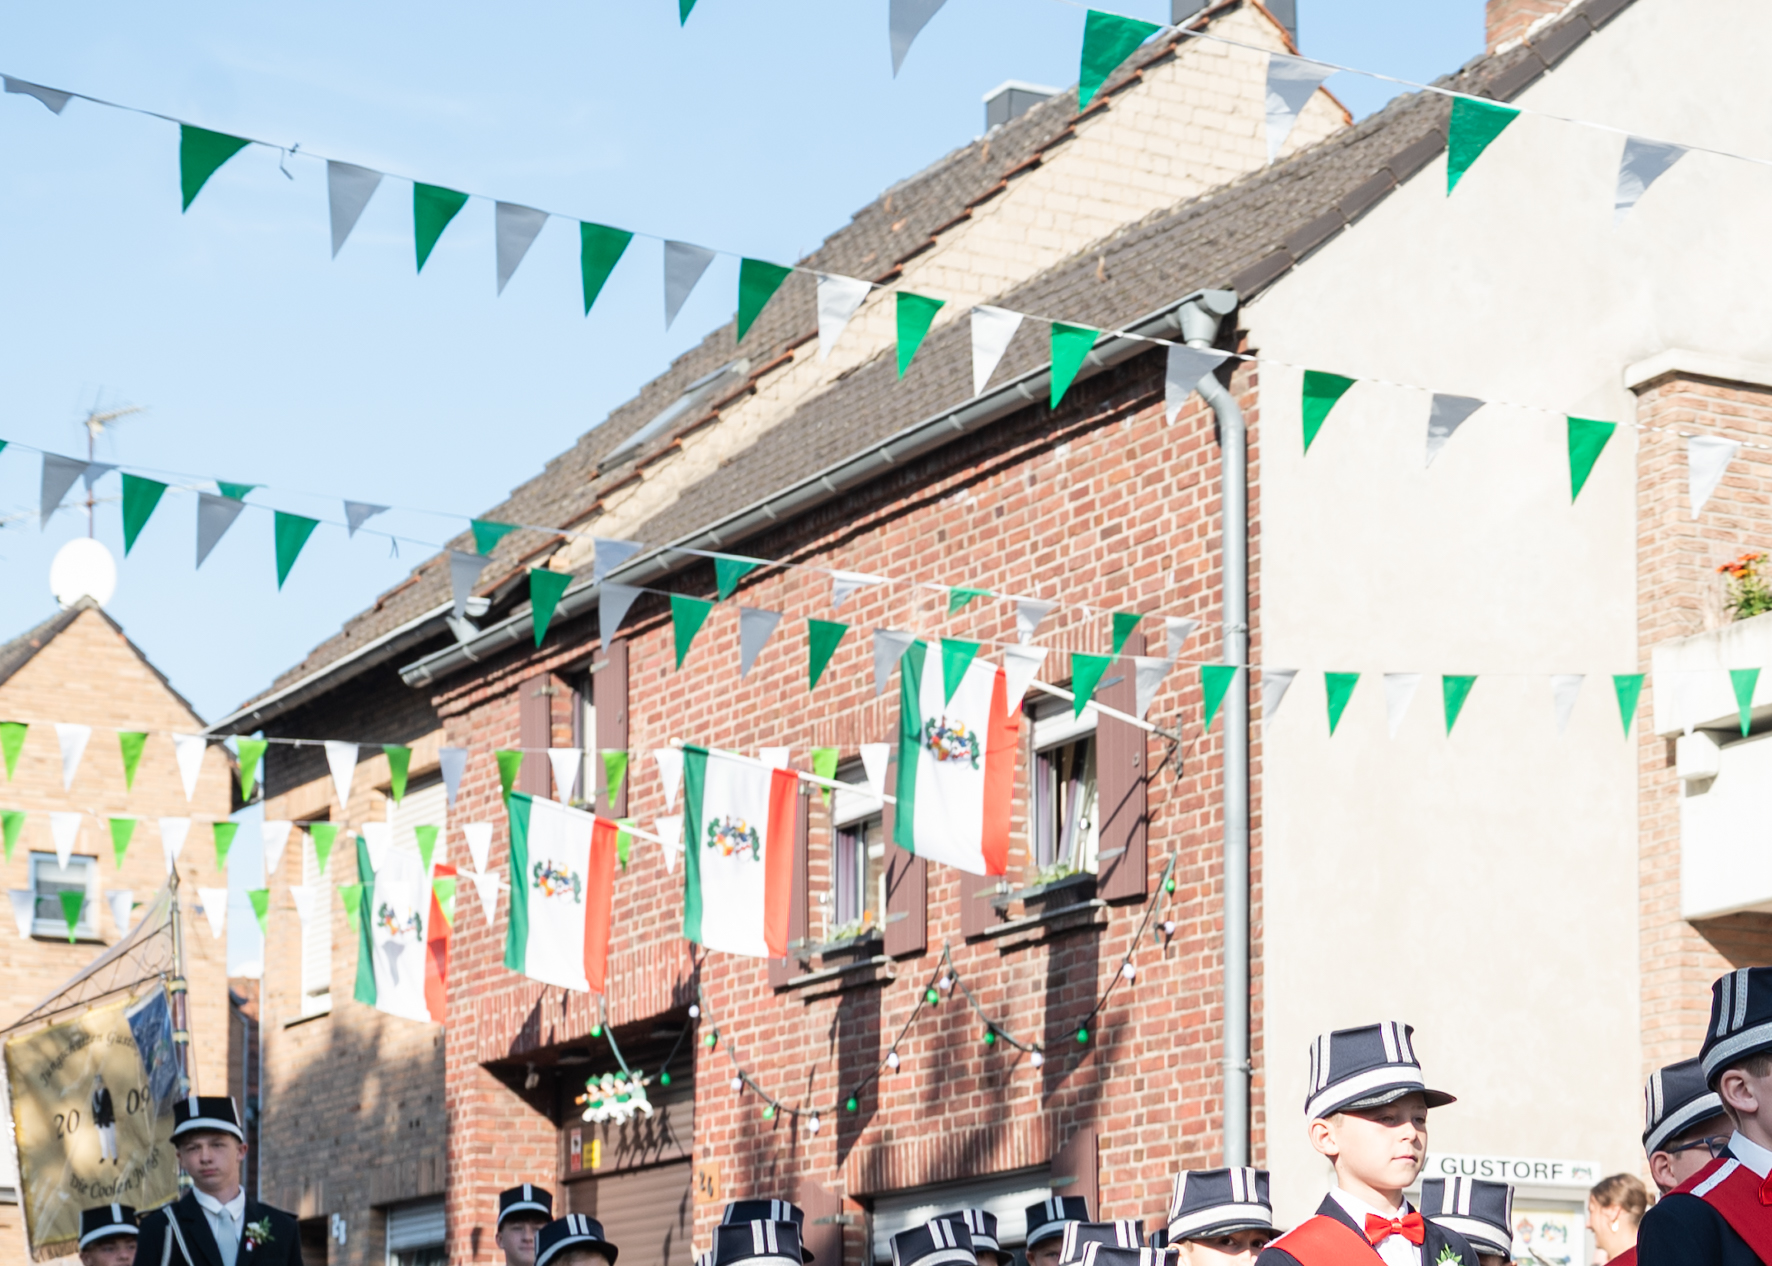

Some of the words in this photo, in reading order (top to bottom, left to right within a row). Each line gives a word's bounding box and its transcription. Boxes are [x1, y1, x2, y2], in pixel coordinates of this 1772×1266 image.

[54, 1108, 80, 1140] 20
[126, 1084, 151, 1115] 09
[1440, 1156, 1564, 1180] GUSTORF
